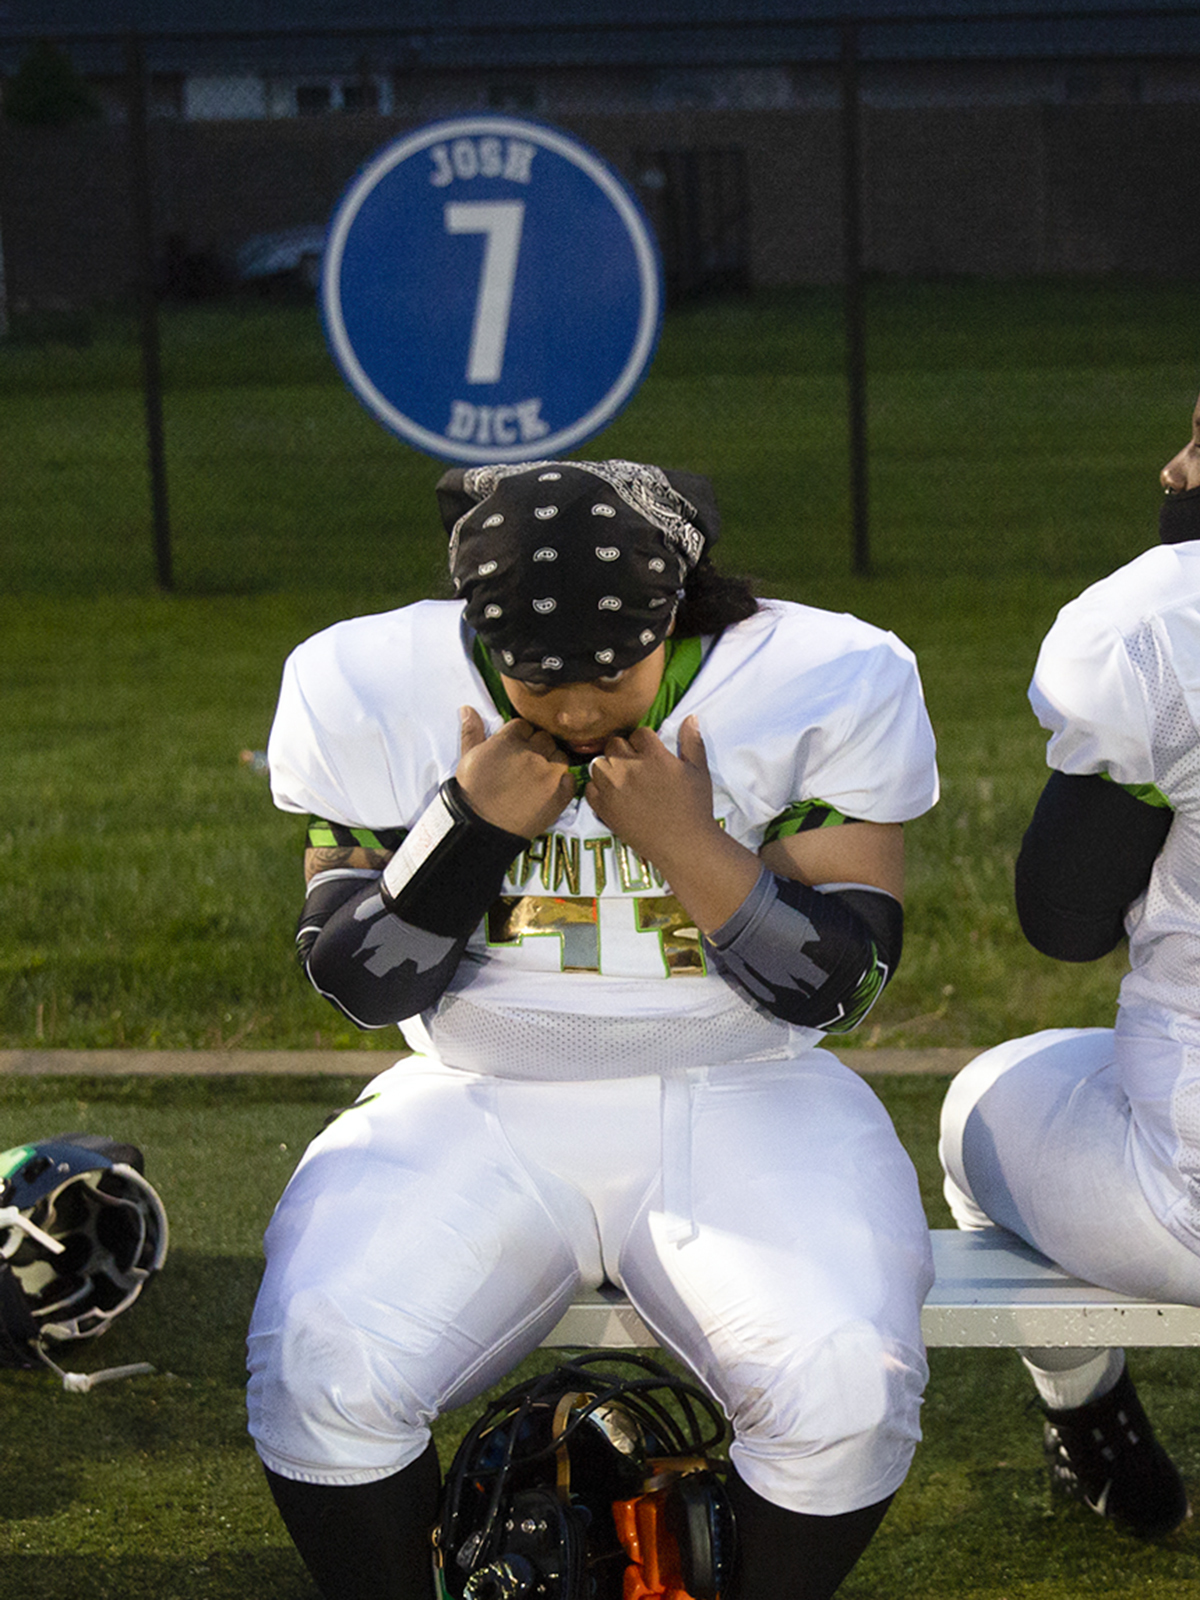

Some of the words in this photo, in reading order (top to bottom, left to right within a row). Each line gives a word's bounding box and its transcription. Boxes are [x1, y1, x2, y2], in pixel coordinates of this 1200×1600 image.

[430, 137, 537, 187] JOSH
[445, 201, 525, 385] 7
[446, 398, 550, 445] DICK
